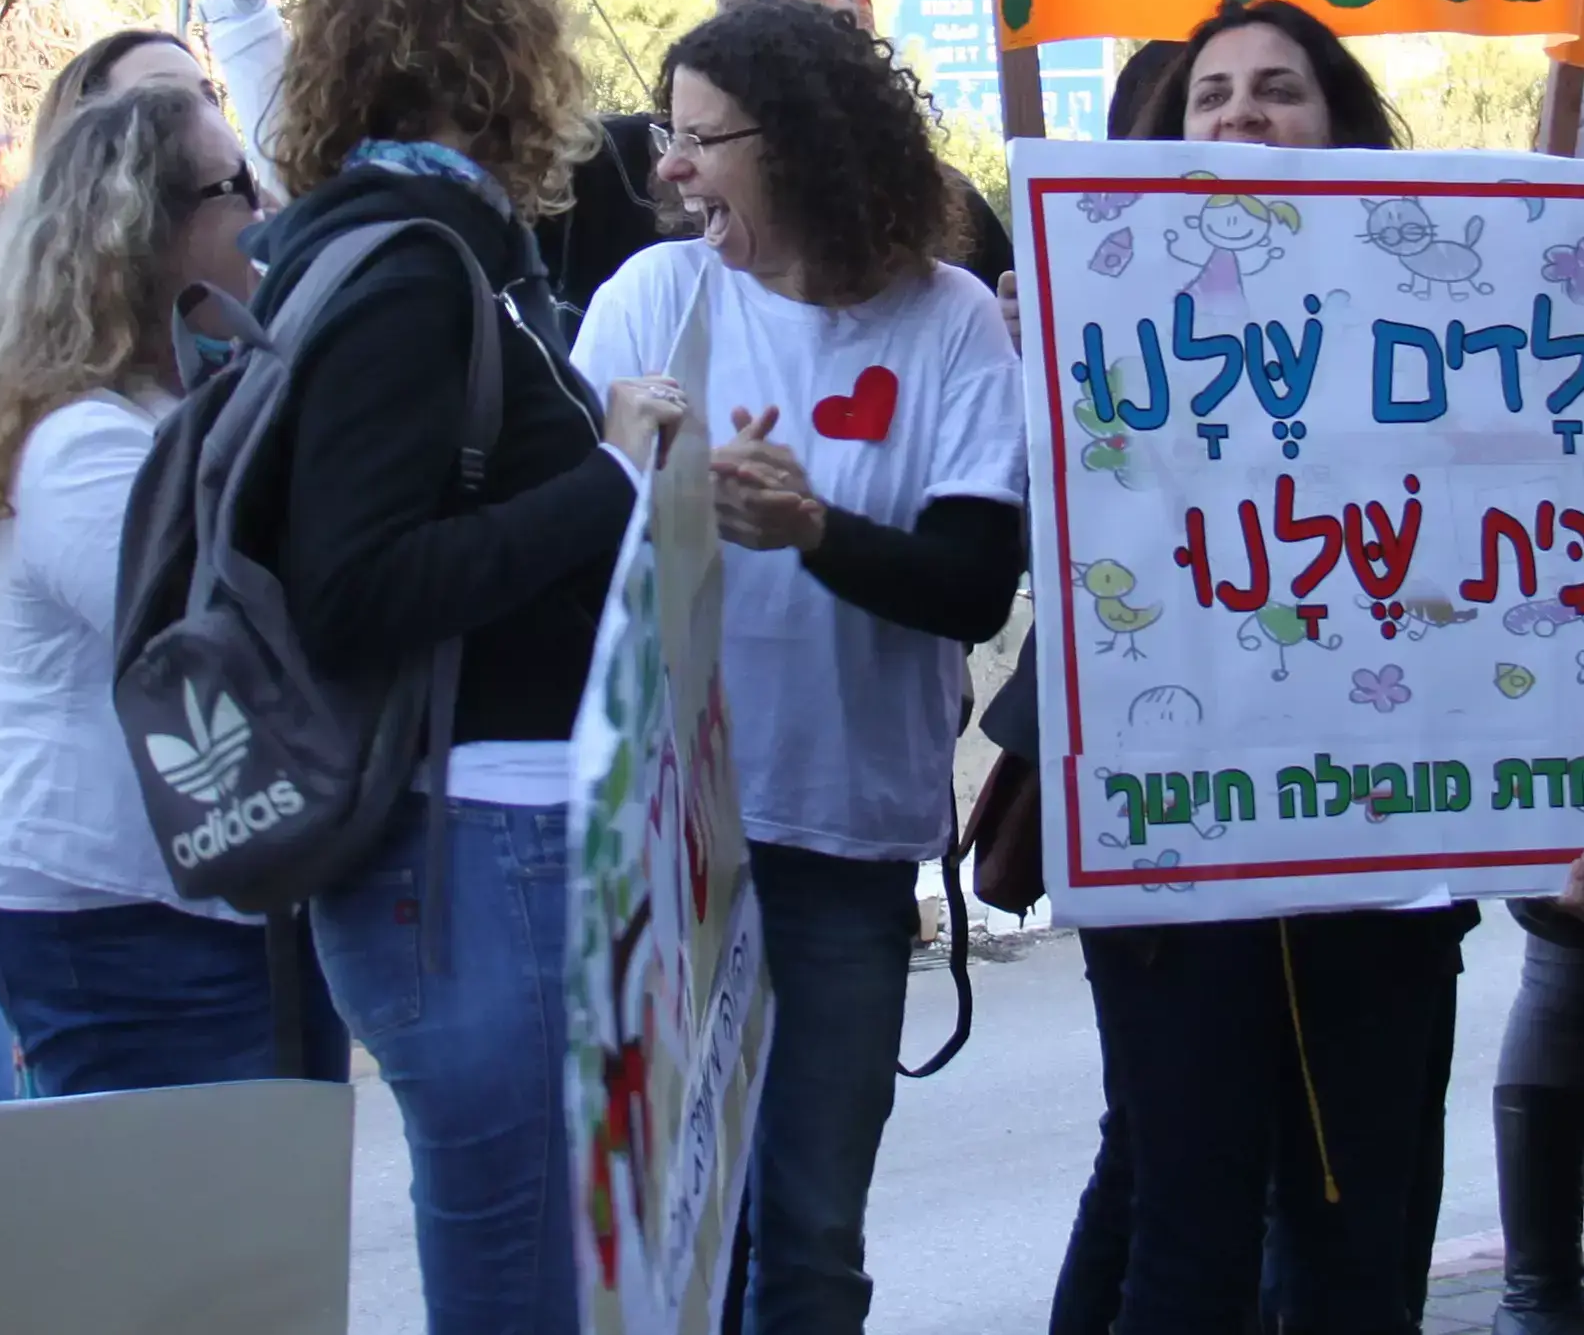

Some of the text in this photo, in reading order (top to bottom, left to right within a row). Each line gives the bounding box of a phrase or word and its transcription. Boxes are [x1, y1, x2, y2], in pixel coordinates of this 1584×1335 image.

[172, 779, 306, 870] adidas
[1104, 767, 1256, 846] חינוך
[1275, 752, 1473, 819] מובילה
